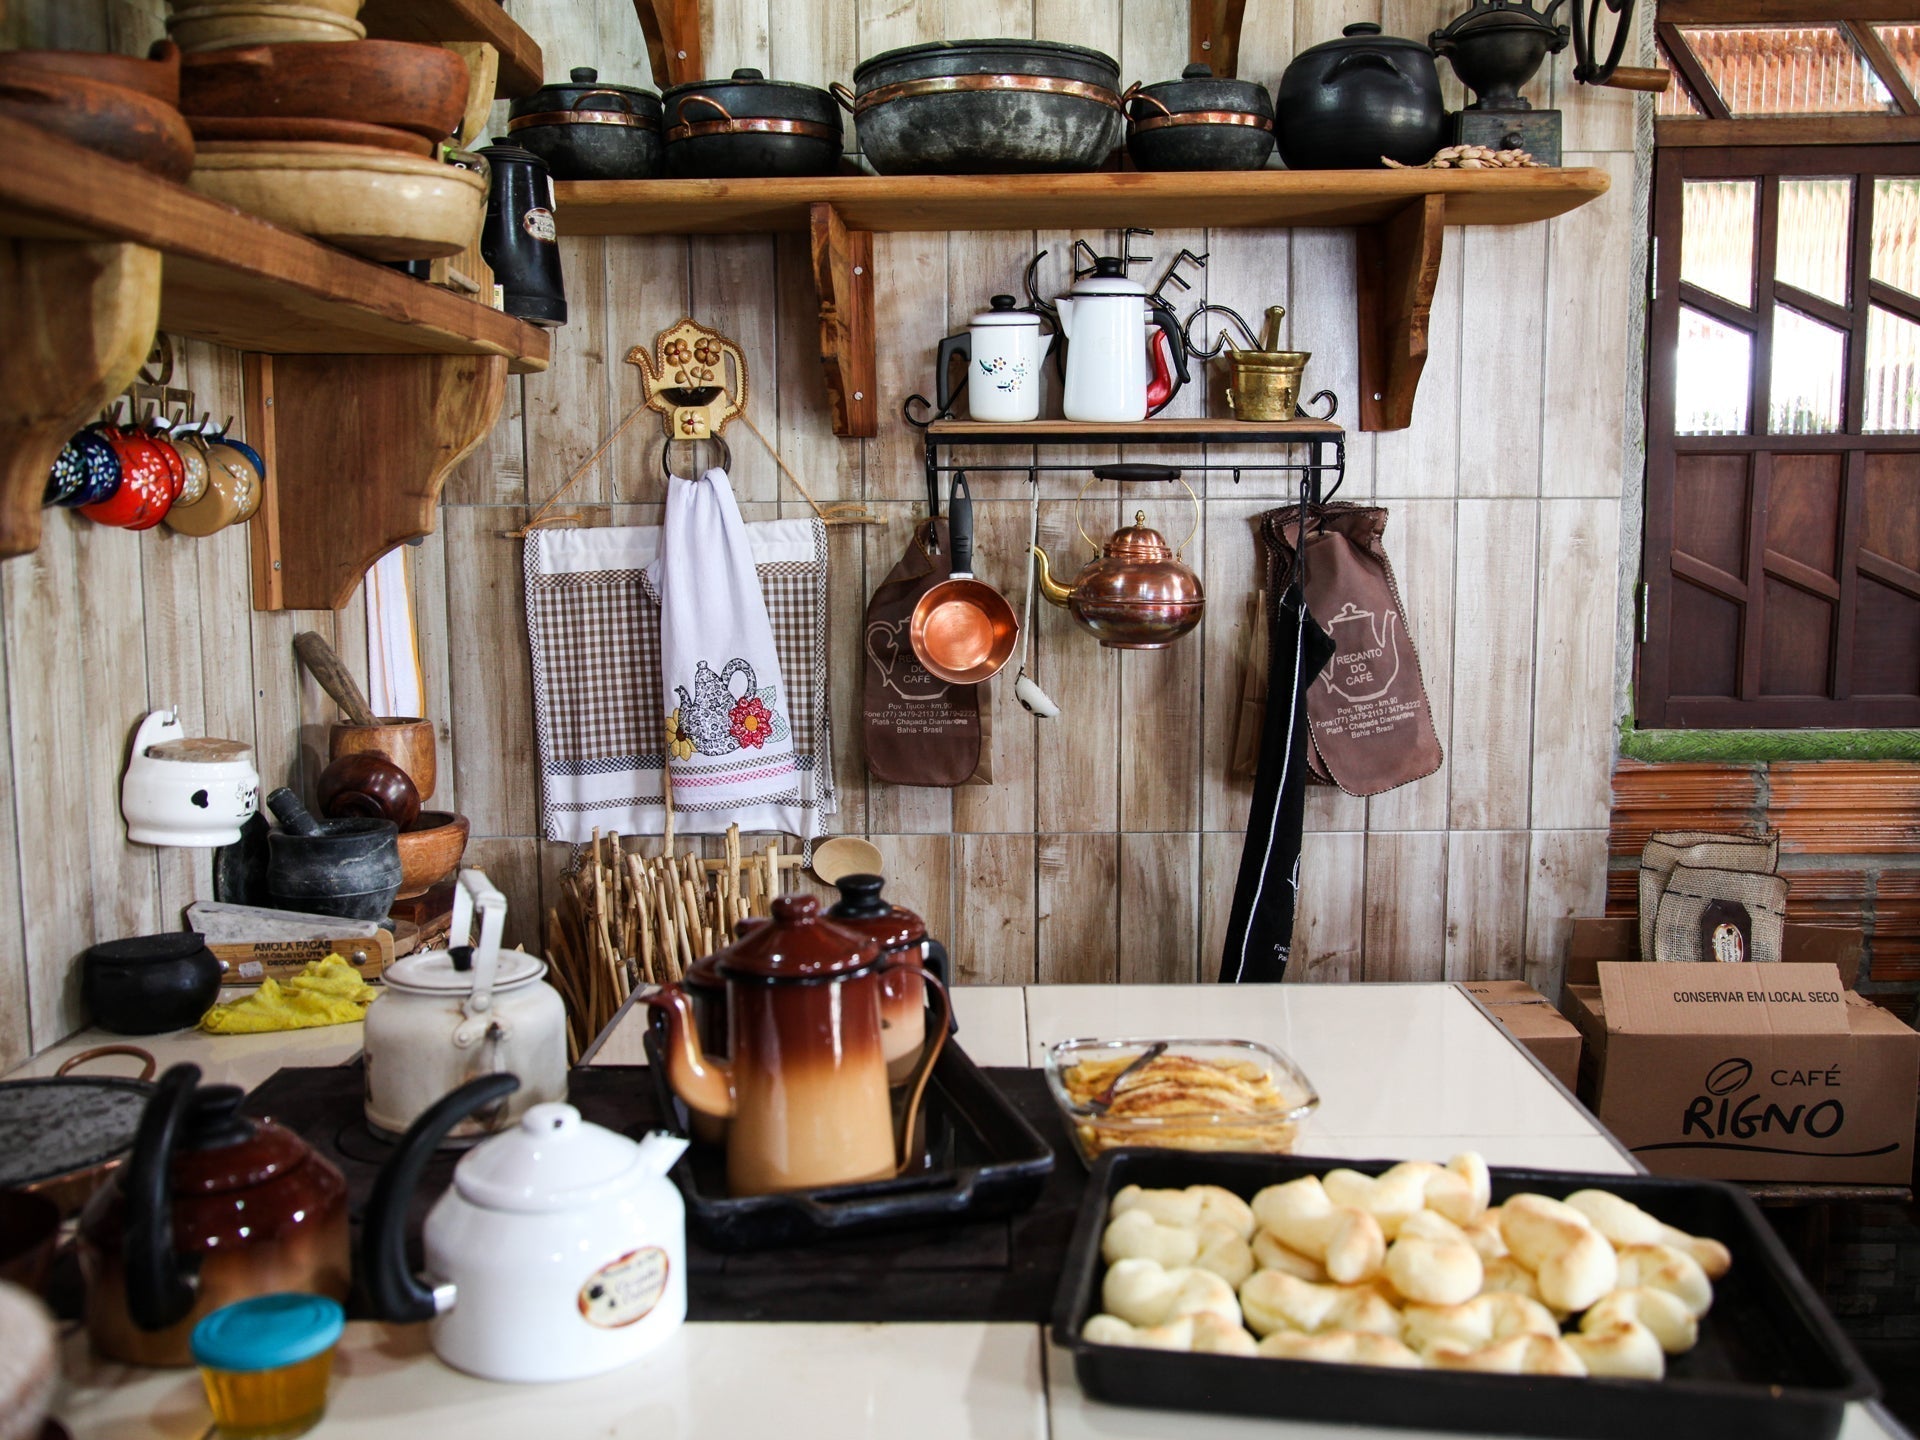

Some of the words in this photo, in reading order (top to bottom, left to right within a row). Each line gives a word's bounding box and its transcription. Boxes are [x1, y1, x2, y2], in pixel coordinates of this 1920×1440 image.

[1336, 648, 1383, 665] RECANTO
[1350, 663, 1367, 674] DO
[903, 673, 931, 683] CAFÉ
[1345, 671, 1375, 686] CAFÉ
[253, 942, 294, 952] AMOLA
[1673, 991, 1744, 1003] CONSERVAR
[1747, 992, 1765, 1003] EM
[1768, 991, 1806, 1003] LOCAL
[1809, 991, 1839, 1003] SECO
[1771, 1064, 1841, 1087] CAFÉ
[1682, 1094, 1844, 1139] RIGNO
